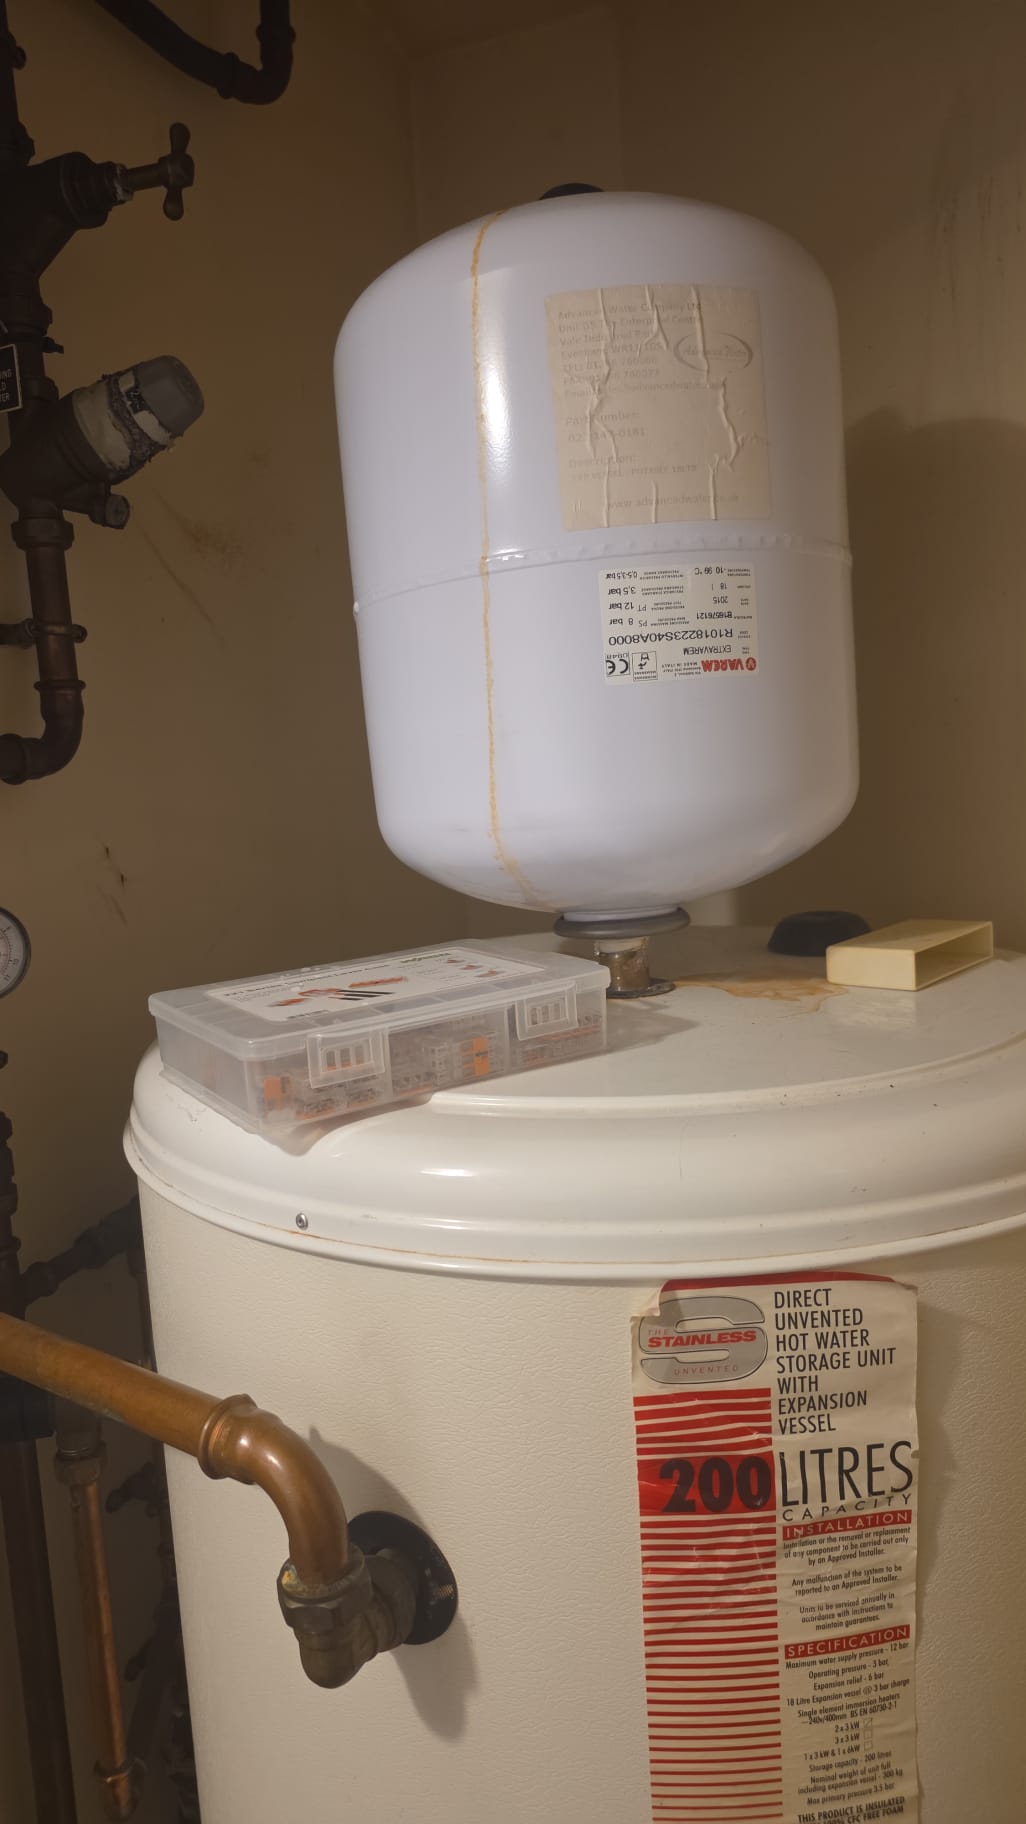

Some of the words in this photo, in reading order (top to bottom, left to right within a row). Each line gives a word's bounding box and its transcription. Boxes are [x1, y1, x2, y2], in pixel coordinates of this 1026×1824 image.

[608, 588, 621, 596] bar
[623, 585, 636, 594] 3,5
[713, 596, 728, 604] 2015
[608, 629, 732, 646] R1018223S40A8000
[683, 645, 731, 655] EXTRAVAREM
[700, 659, 743, 672] VAREM
[774, 1289, 832, 1309] DIRECT
[775, 1308, 863, 1331] UNVENTED
[648, 1330, 757, 1348] STAINLESS
[775, 1333, 808, 1352] HOT
[815, 1329, 869, 1349] WATER
[776, 1353, 851, 1373] STORAGE
[857, 1348, 896, 1367] UNIT
[673, 1365, 738, 1376] UNVENTED
[777, 1376, 818, 1394] WITH
[778, 1391, 867, 1415] EXPANSION
[779, 1415, 836, 1435] VESSEL
[659, 1455, 772, 1512] 200
[779, 1441, 913, 1507] LITRES
[782, 1493, 912, 1522] CAPACITY
[787, 1512, 908, 1538] INSTALLATION
[839, 1532, 863, 1541] removal
[873, 1527, 911, 1538] replacement
[784, 1550, 791, 1558] of
[806, 1545, 840, 1556] component
[860, 1539, 881, 1548] carried
[895, 1536, 909, 1544] only
[808, 1558, 815, 1566] by
[828, 1552, 857, 1562] Approved
[792, 1579, 804, 1587] Any
[806, 1572, 842, 1584] malfunction
[864, 1567, 884, 1575] system
[795, 1586, 822, 1596] reported
[842, 1579, 871, 1589] Approved
[835, 1597, 859, 1608] serviced
[861, 1592, 887, 1604] annually
[802, 1612, 835, 1623] accordance
[837, 1608, 850, 1617] with
[852, 1603, 885, 1615] instructions
[816, 1622, 843, 1631] maintain
[788, 1628, 907, 1657] SPECIFICATION
[786, 1658, 817, 1669] Maximum
[819, 1657, 836, 1665] water
[838, 1652, 857, 1662] supply
[859, 1648, 884, 1658] pressure
[890, 1644, 897, 1652] 12
[809, 1669, 840, 1679] Operating
[841, 1664, 866, 1674] pressure
[797, 1697, 810, 1705] Litre
[812, 1692, 842, 1703] Expansion
[844, 1689, 861, 1697] vessel
[880, 1682, 889, 1690] bar
[891, 1678, 910, 1689] charge
[814, 1680, 845, 1691] Expansion
[847, 1677, 862, 1685] relief
[798, 1709, 817, 1717] Single
[819, 1704, 843, 1714] element
[846, 1699, 877, 1710] immersion
[879, 1693, 900, 1703] heaters
[851, 1733, 860, 1741] kW
[809, 1763, 833, 1772] Storage
[835, 1758, 859, 1768] capacity
[865, 1753, 876, 1762] 200
[820, 1750, 829, 1758] kW
[811, 1773, 837, 1784] Nominal
[839, 1769, 859, 1780] weight
[860, 1768, 866, 1776] of
[881, 1760, 891, 1770] full
[798, 1785, 826, 1795] including
[828, 1779, 858, 1790] expansion
[860, 1775, 877, 1784] vessel
[807, 1797, 820, 1805] Max
[822, 1792, 846, 1804] primary
[847, 1788, 872, 1799] pressure
[884, 1782, 895, 1790] bar
[798, 1812, 816, 1823] THIS
[818, 1806, 853, 1820] PRODUCT
[866, 1796, 905, 1810] INSULATED
[847, 1814, 862, 1824] CFC
[864, 1810, 881, 1820] FREE
[883, 1805, 904, 1816] FOAM
